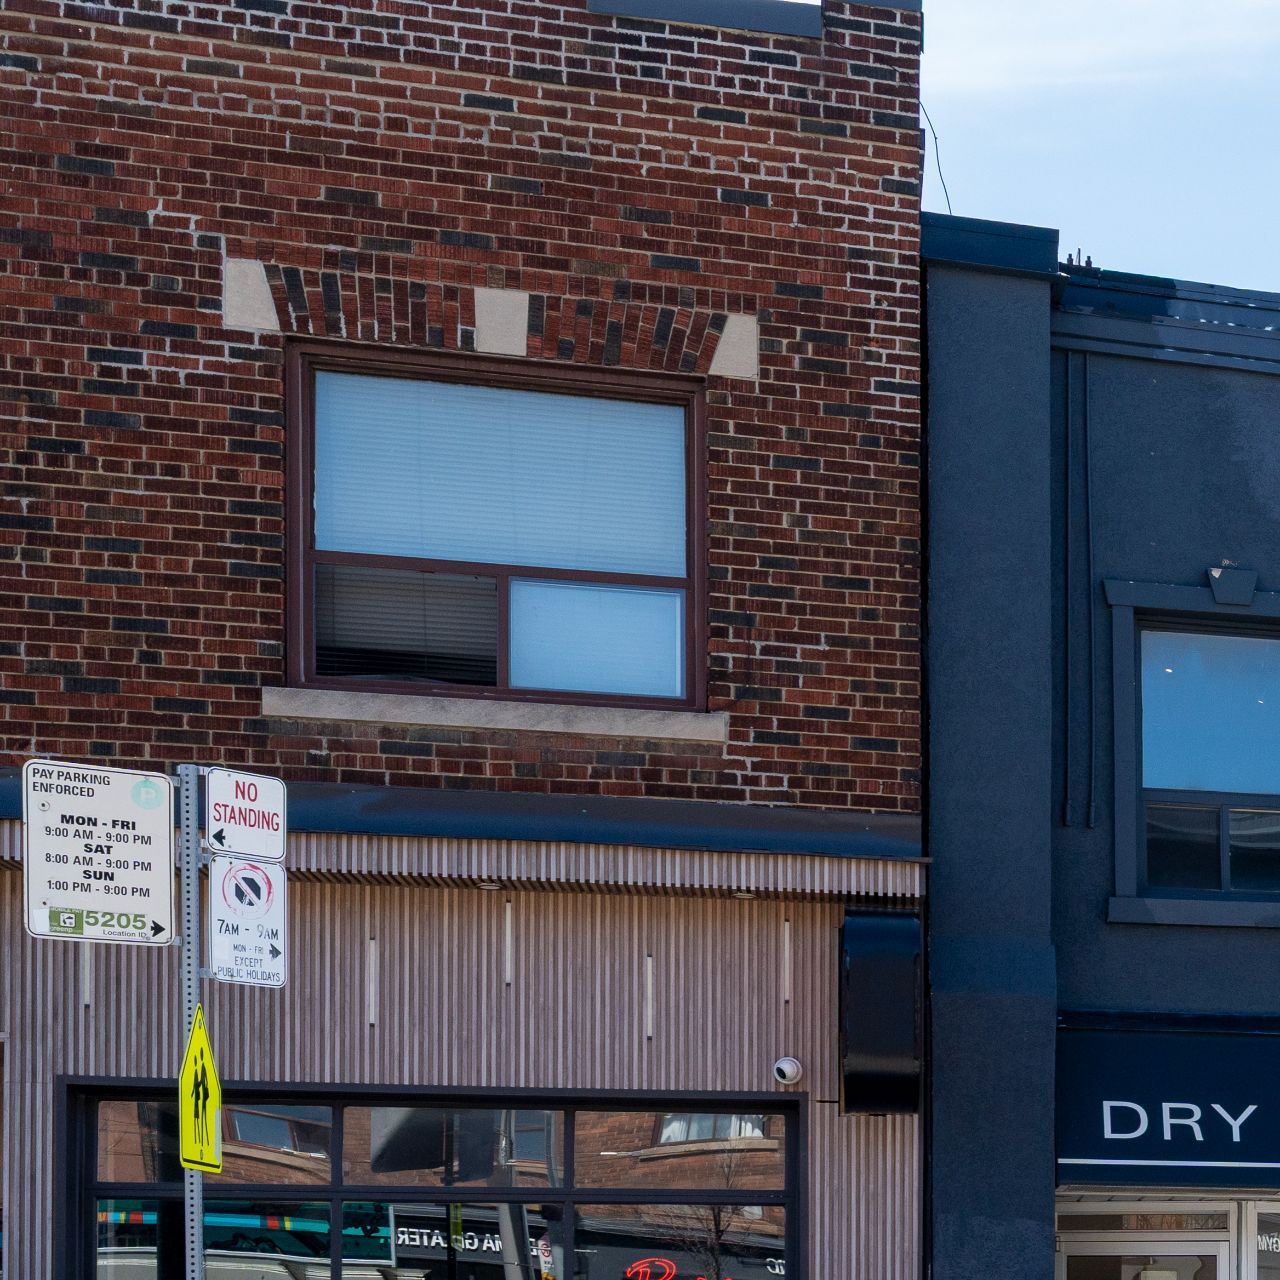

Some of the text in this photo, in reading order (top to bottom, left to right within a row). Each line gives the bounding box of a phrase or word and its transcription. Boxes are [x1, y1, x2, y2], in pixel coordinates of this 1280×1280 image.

[32, 768, 111, 786] PAY PARKING
[32, 782, 95, 798] ENFORCED
[235, 780, 258, 802] NO
[60, 814, 98, 828] MON
[111, 818, 136, 831] FRI
[213, 802, 280, 832] STANDING
[45, 826, 69, 838] 9:00
[73, 828, 94, 840] AM
[105, 830, 129, 842] 9:00
[133, 833, 152, 845] PM
[83, 843, 113, 855] SAT
[45, 853, 69, 865] 8:00
[73, 855, 94, 867] AM
[105, 857, 129, 869] 9:00
[133, 859, 152, 872] PM
[82, 869, 115, 882] SUN
[47, 880, 69, 892] 1:00
[73, 882, 92, 894] PM
[104, 884, 128, 896] 9:00
[131, 886, 150, 898] PM
[85, 910, 147, 930] 5205
[103, 929, 136, 938] Location
[217, 919, 239, 936] 7AM
[257, 923, 279, 940] 9AM
[233, 944, 247, 952] MON
[234, 956, 263, 968] EXCEPT
[217, 966, 281, 982] PUBLIC HOLIDAYS
[1102, 1100, 1258, 1142] DRY
